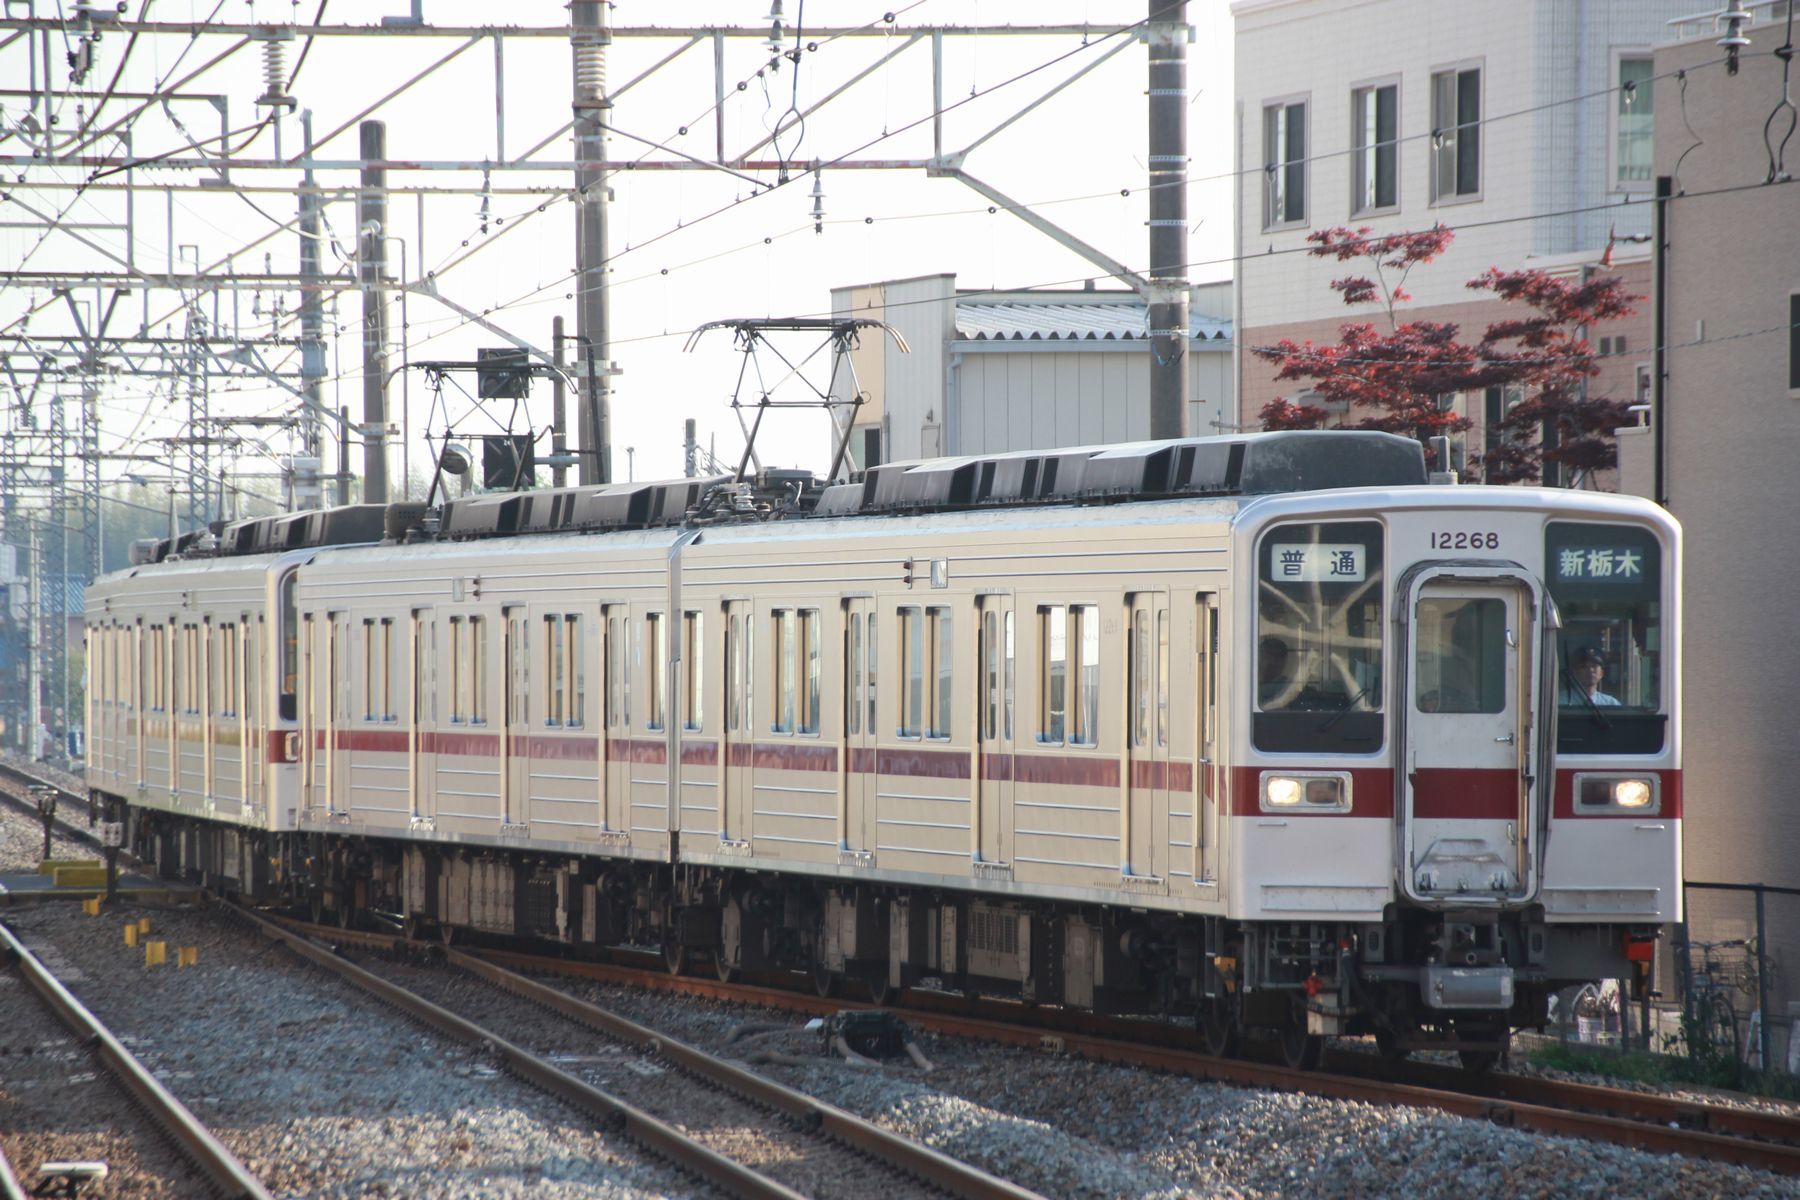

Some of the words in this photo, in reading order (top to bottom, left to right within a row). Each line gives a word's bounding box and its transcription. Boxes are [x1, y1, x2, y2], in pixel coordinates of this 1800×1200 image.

[1431, 532, 1499, 549] 12268
[1280, 550, 1357, 575] 普通
[1560, 549, 1641, 577] 新栃木
